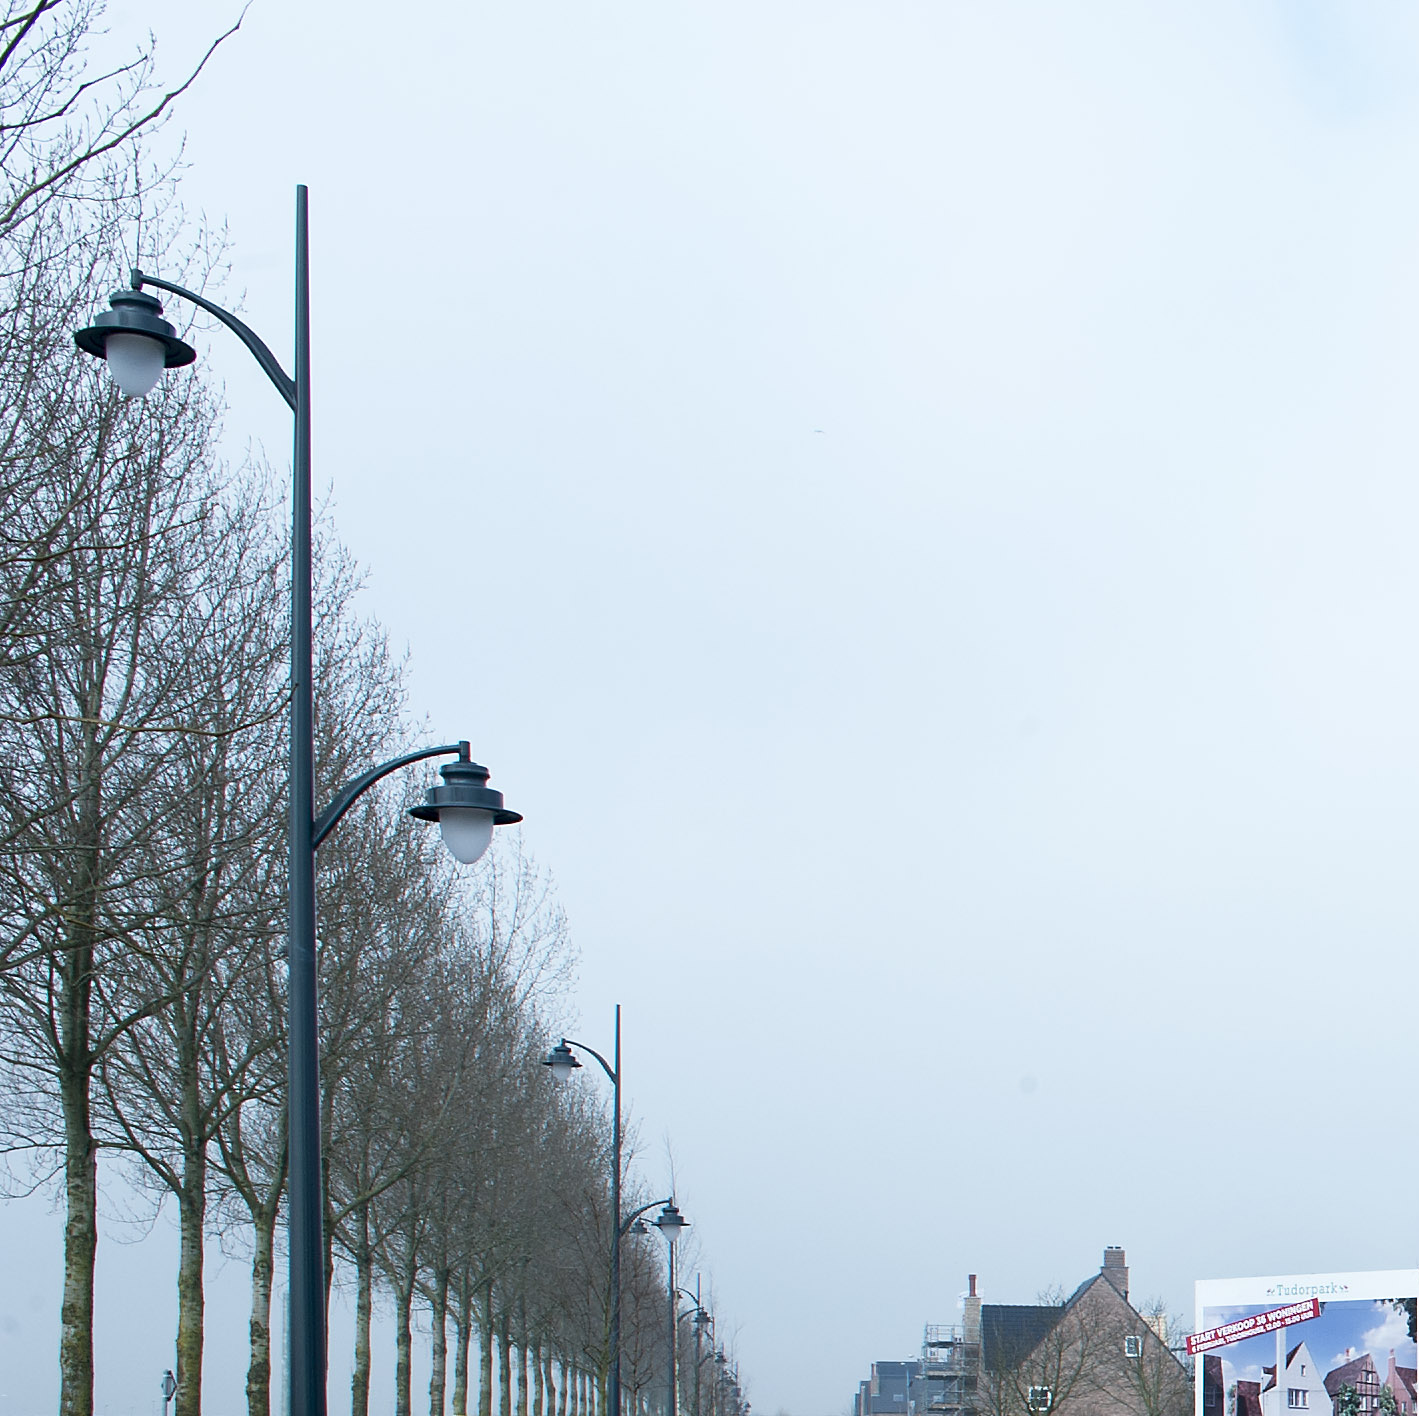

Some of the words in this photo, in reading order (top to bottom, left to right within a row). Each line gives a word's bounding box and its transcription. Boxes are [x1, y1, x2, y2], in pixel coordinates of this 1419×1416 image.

[1277, 1282, 1337, 1297] Tudorpark
[1190, 1330, 1216, 1346] START
[1217, 1319, 1255, 1337] VERKOOP
[1267, 1300, 1313, 1321] WONINGEN
